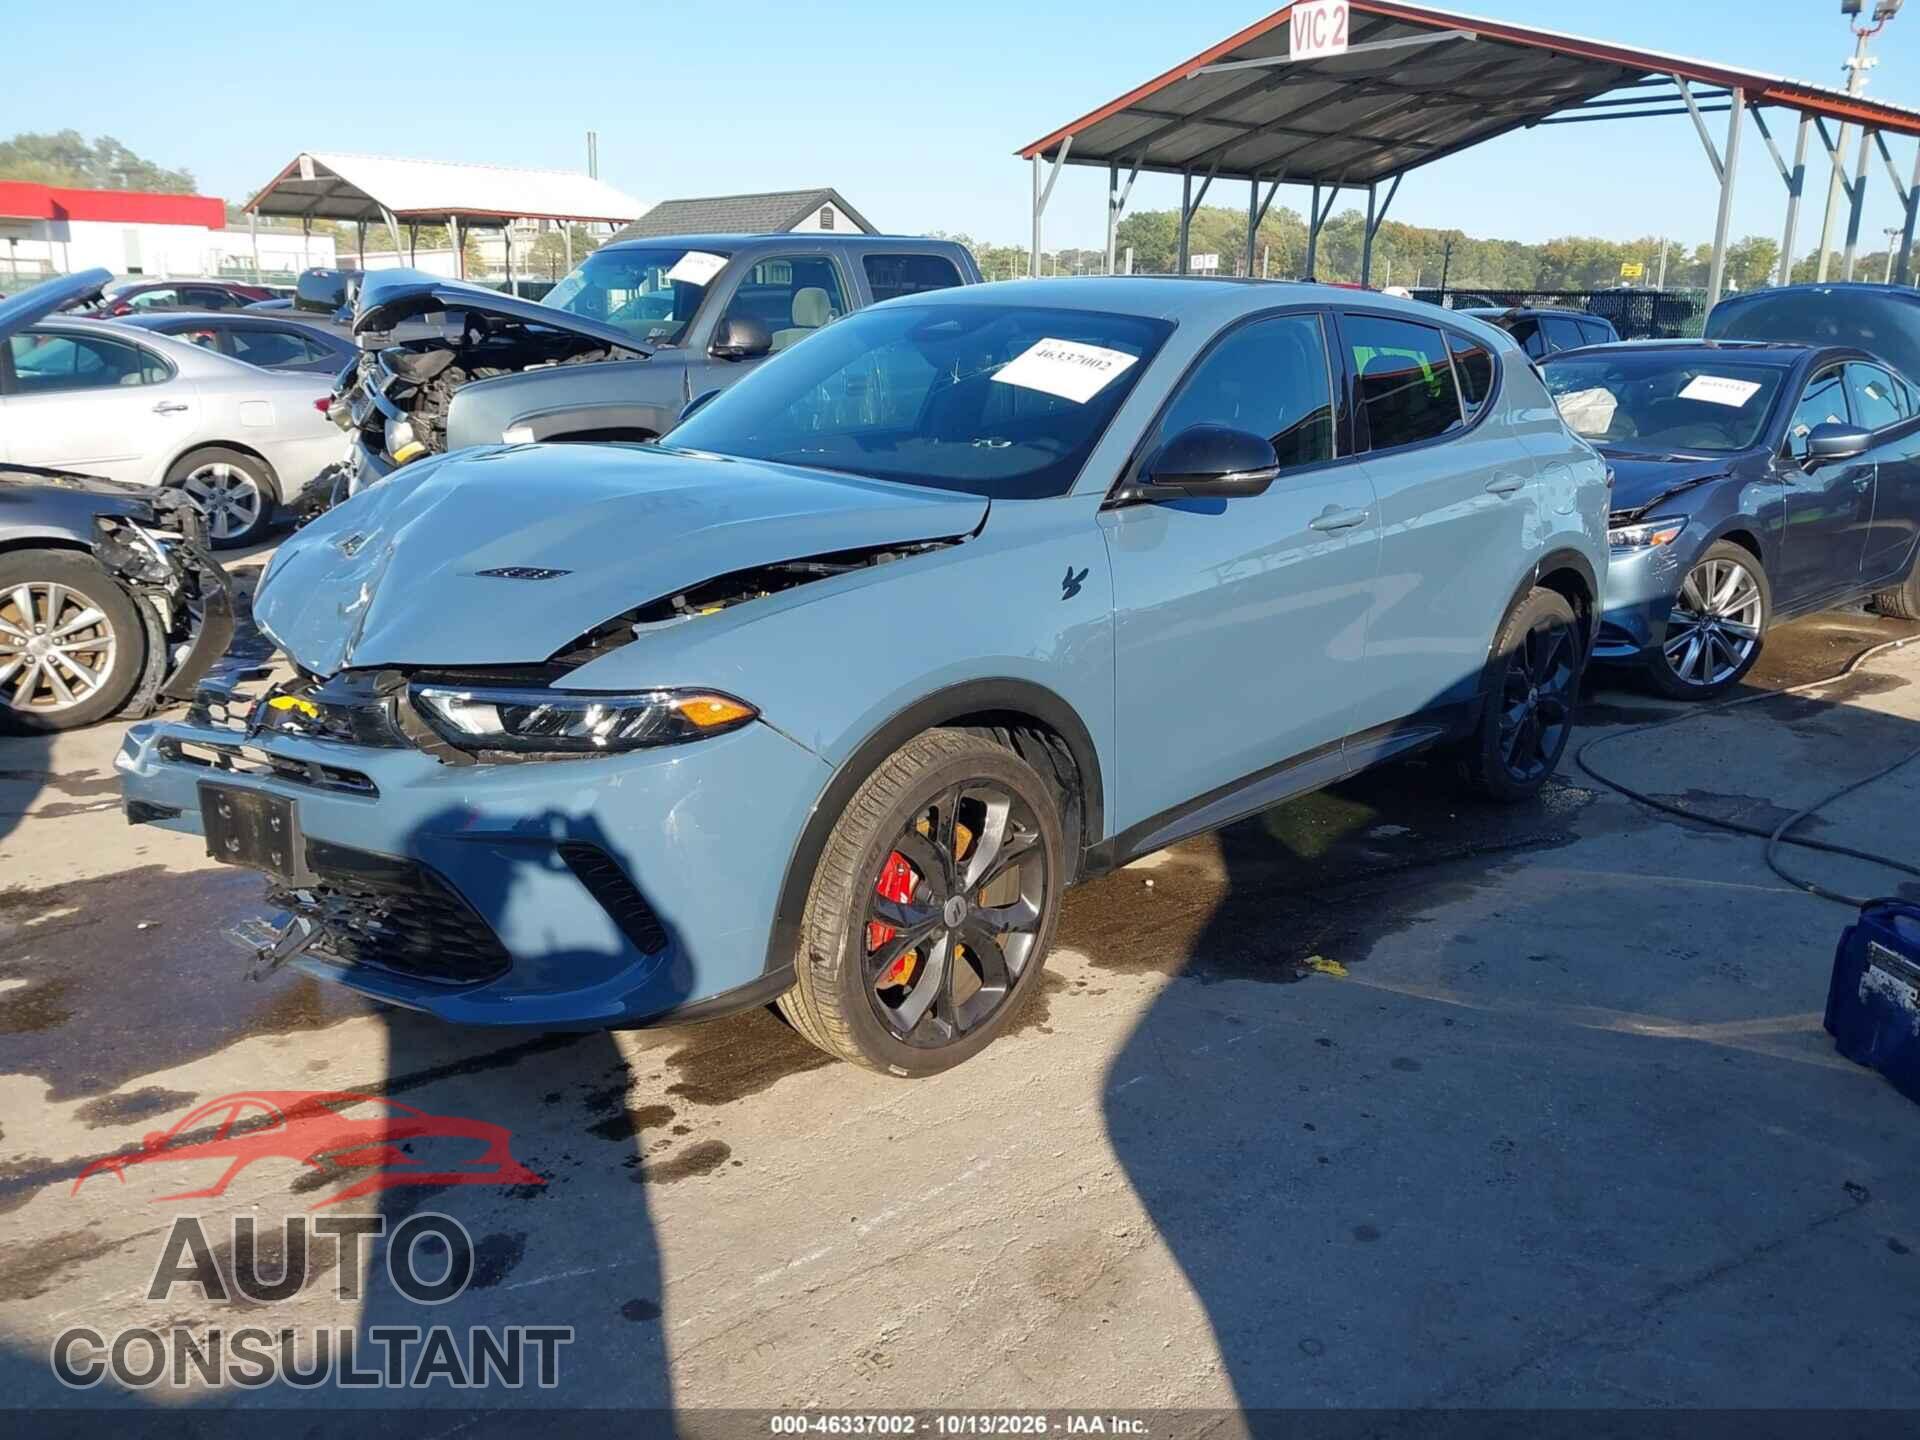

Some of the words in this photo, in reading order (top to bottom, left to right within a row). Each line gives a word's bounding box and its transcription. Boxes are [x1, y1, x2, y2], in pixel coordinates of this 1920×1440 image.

[1293, 9, 1326, 51] VIC
[1332, 5, 1346, 46] 2
[1036, 348, 1112, 370] 46337002
